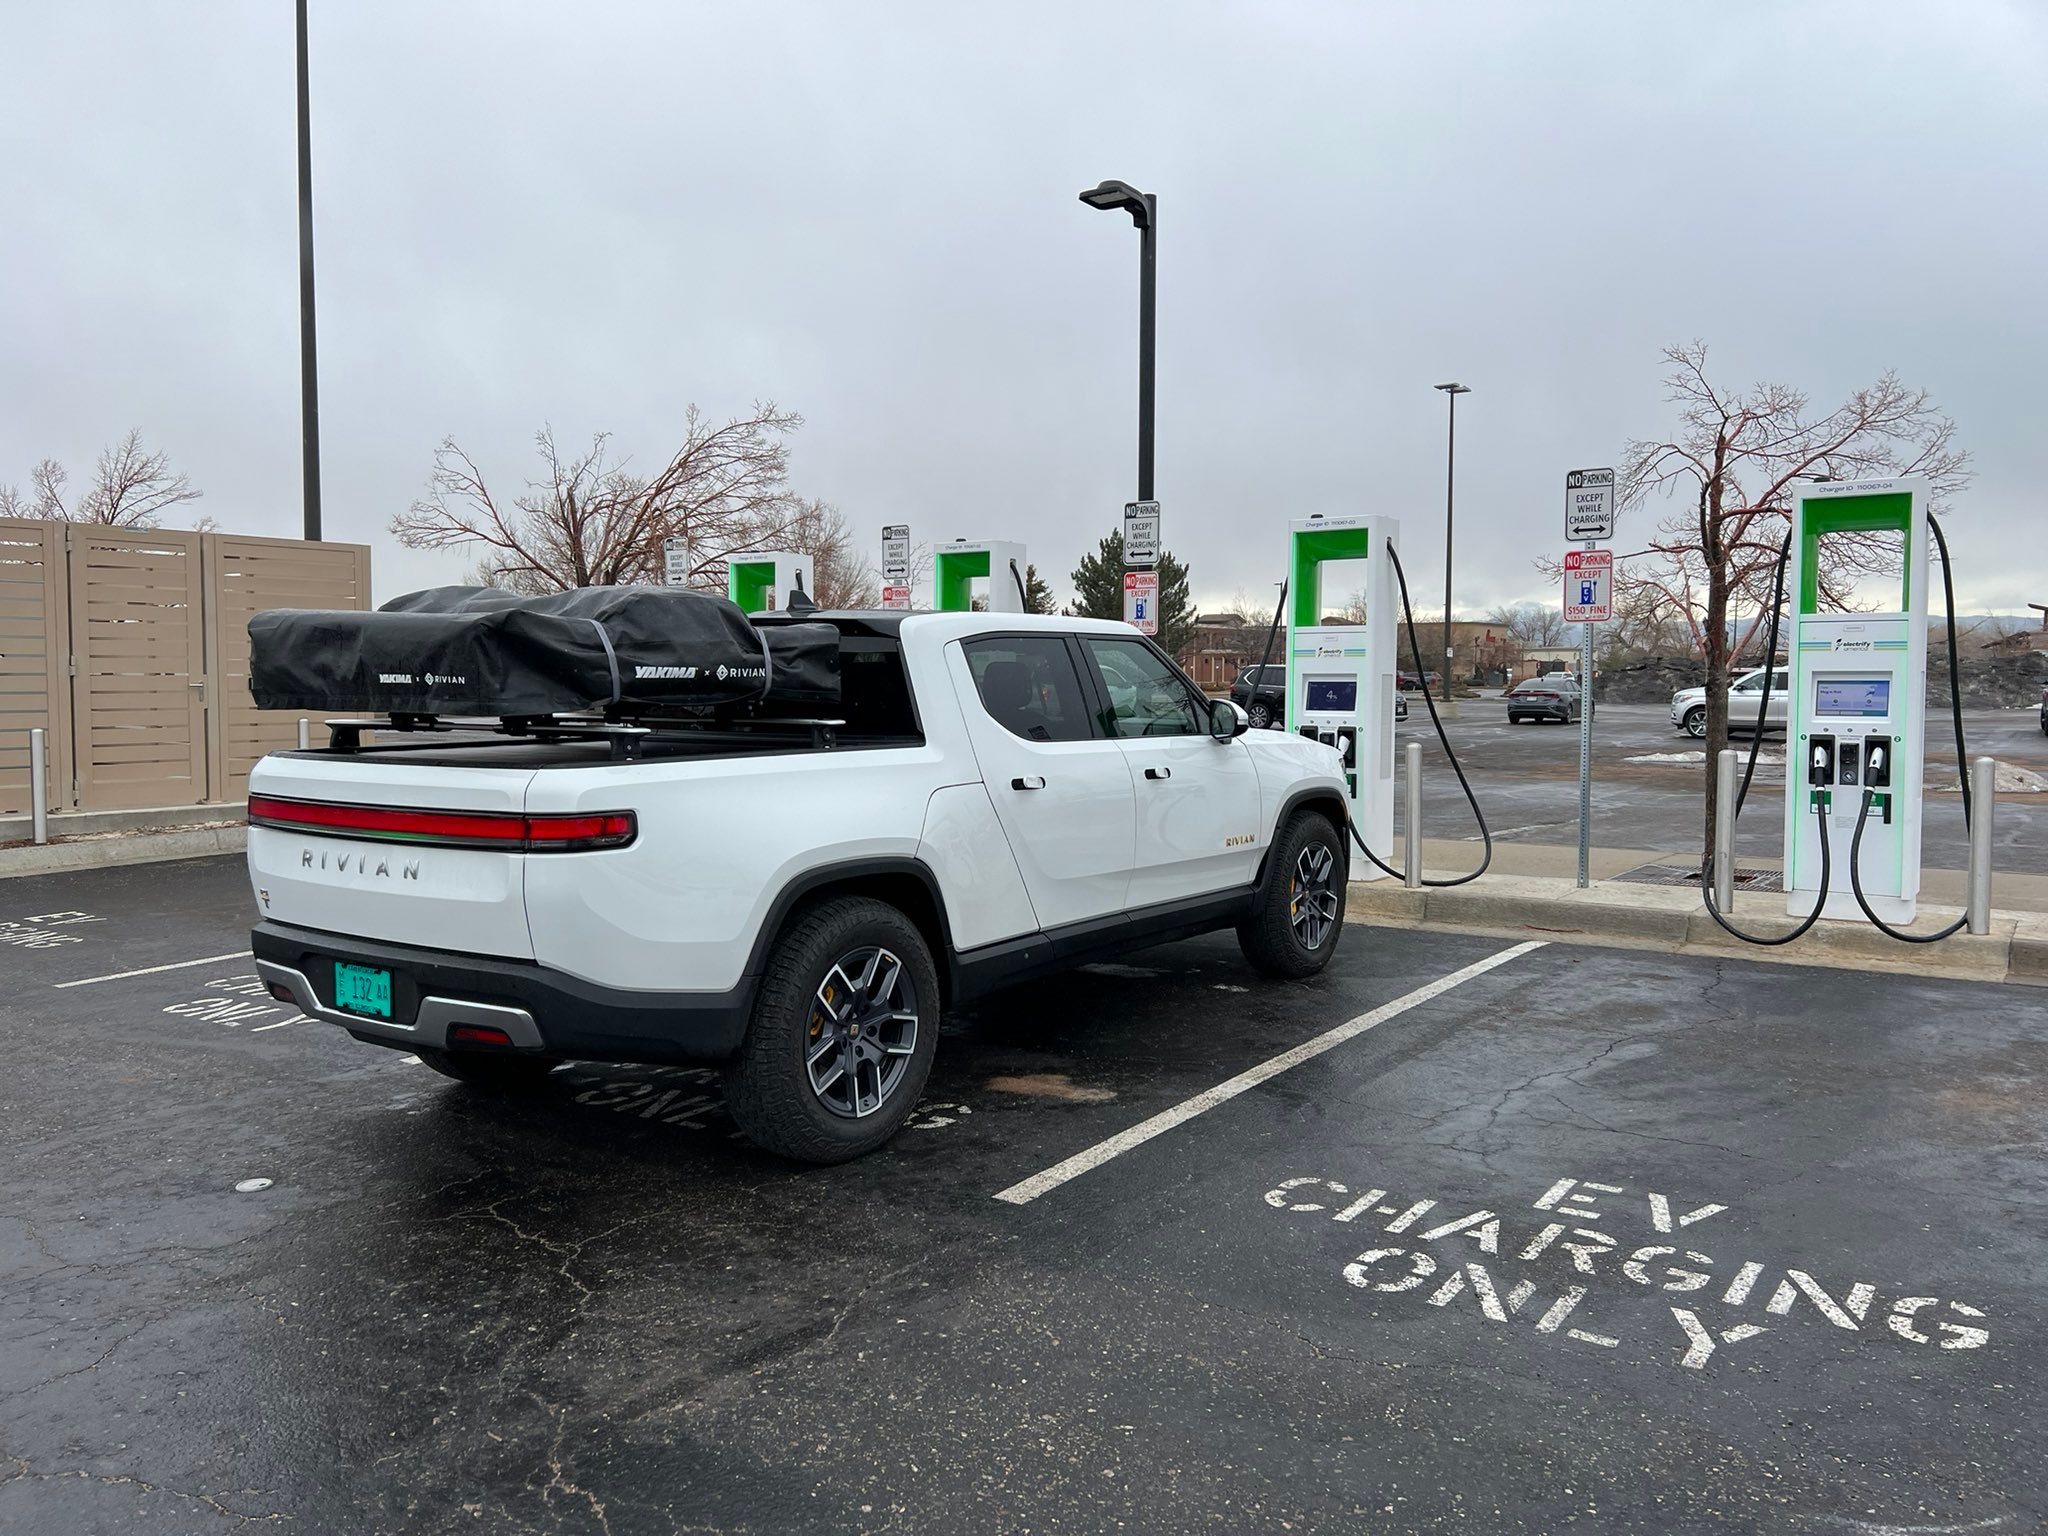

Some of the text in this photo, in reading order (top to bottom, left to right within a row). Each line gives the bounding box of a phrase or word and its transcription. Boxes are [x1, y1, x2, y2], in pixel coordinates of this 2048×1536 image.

[1568, 472, 1612, 487] NO PARKING
[1576, 493, 1604, 503] EXCEPT
[1126, 505, 1158, 517] NO PARKING
[1577, 504, 1602, 513] WHILE
[1569, 513, 1610, 525] CHARGING
[1131, 522, 1152, 531] EXCEPT
[1132, 532, 1151, 540] WHILE
[1127, 540, 1156, 549] CHARGING
[1567, 554, 1610, 567] NO PARKING
[1574, 570, 1602, 579] EXCEPT
[1126, 576, 1156, 587] NO PARKING
[1568, 605, 1607, 615] $150 FINE
[1142, 620, 1154, 628] FINE
[379, 673, 412, 684] YAKIMA
[435, 675, 465, 684] RIVIAN
[635, 666, 699, 679] YAKIMA
[729, 668, 766, 678] RIVIAN
[1226, 833, 1255, 848] RIVIAN
[302, 849, 420, 880] RIVIAN
[24, 911, 107, 926] EV
[352, 975, 388, 1002] 132 AA
[163, 998, 320, 1032] ONLY
[1533, 1178, 1729, 1233] EV
[1264, 1177, 1990, 1350] CHARGING
[1342, 1247, 1770, 1369] ONLY
